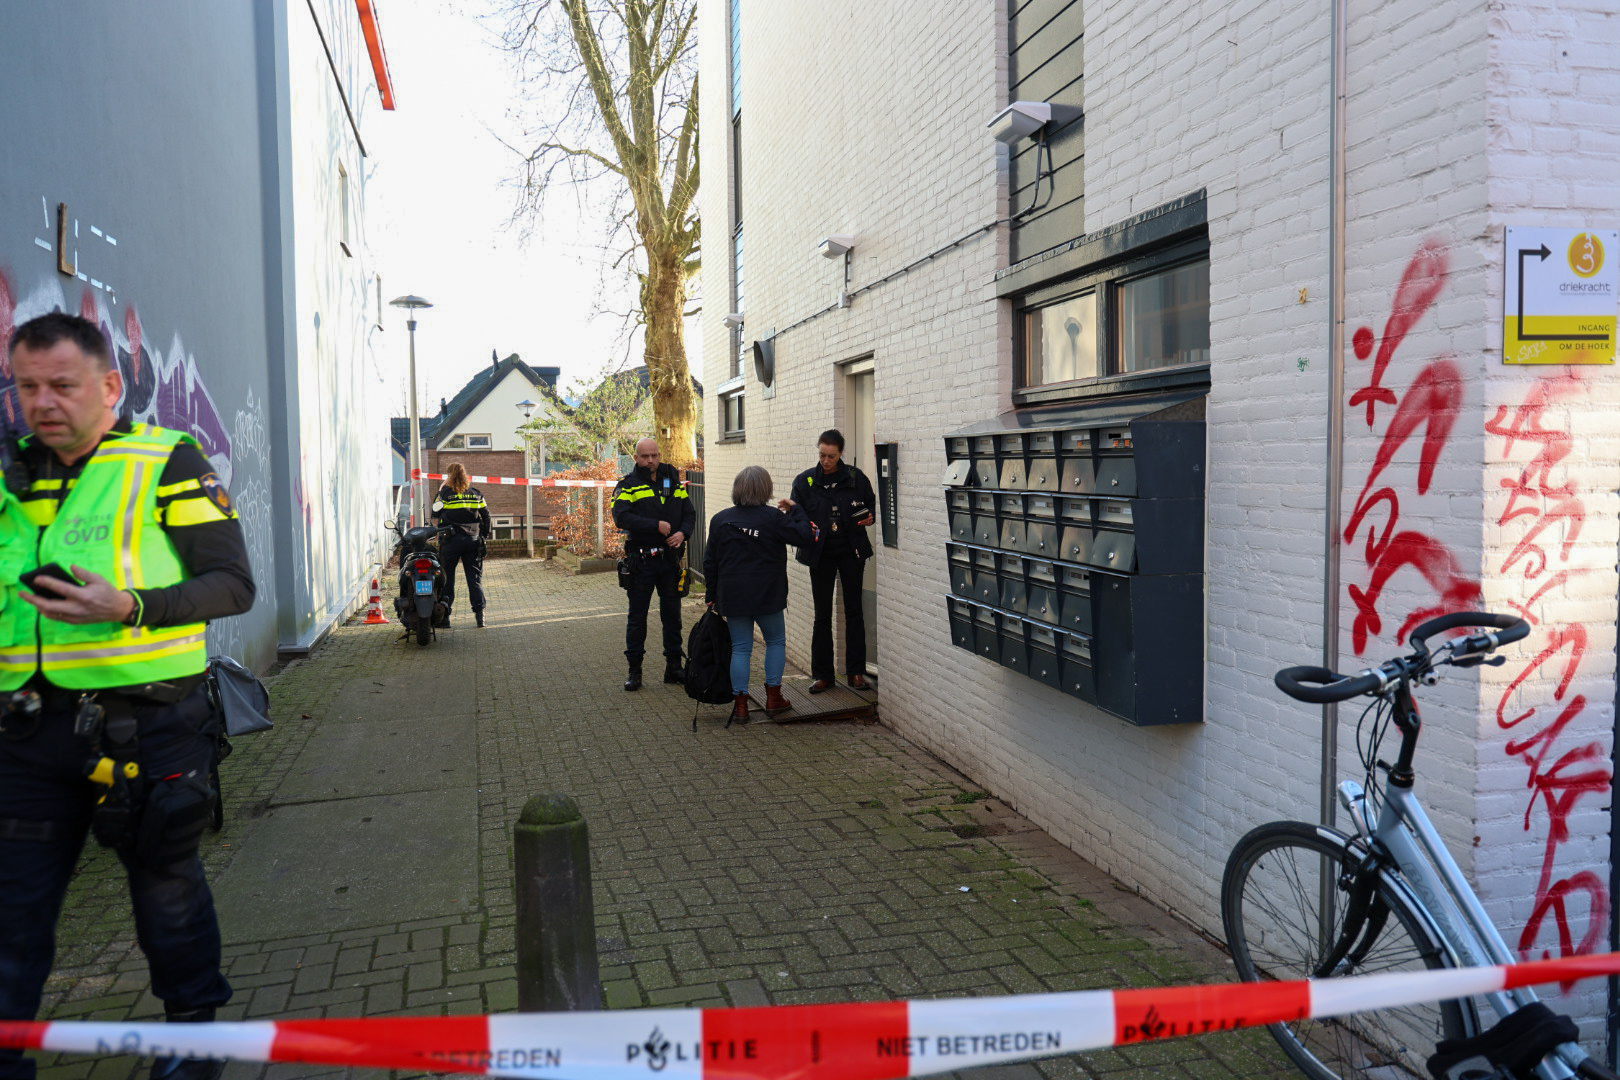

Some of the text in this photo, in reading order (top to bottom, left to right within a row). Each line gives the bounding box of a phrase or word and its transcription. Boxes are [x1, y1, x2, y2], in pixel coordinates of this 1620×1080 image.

[1559, 282, 1611, 292] driekracht
[1578, 324, 1610, 332] INGANG
[1559, 343, 1573, 351] OM
[63, 525, 110, 546] OVD
[876, 1036, 930, 1058] NIET
[937, 1031, 1062, 1056] BETREDEN
